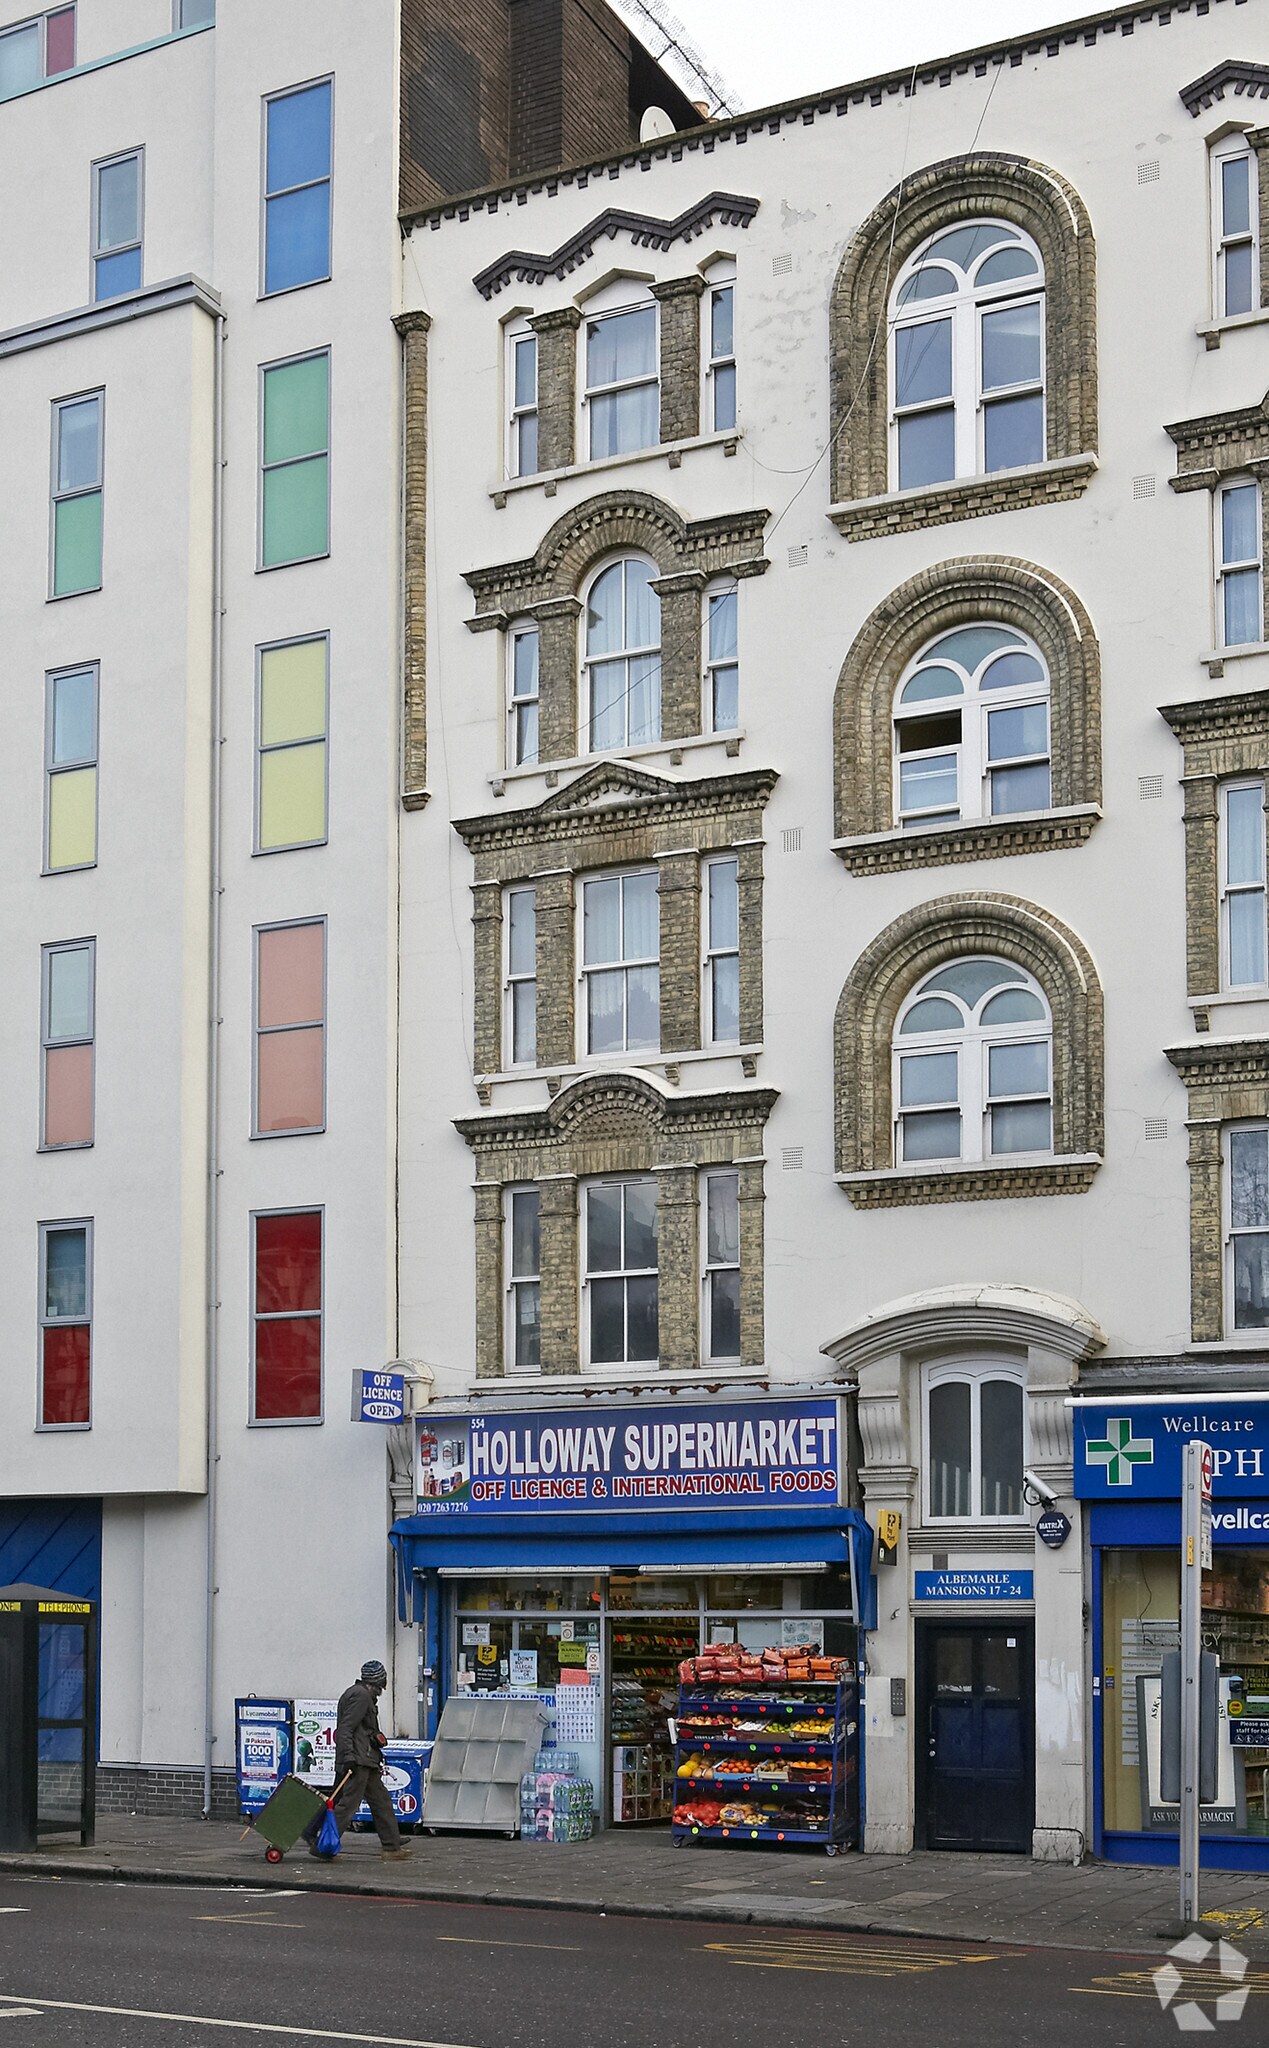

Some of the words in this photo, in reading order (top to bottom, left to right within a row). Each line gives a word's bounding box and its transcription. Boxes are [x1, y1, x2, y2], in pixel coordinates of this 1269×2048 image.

[374, 1374, 392, 1386] OFF
[363, 1386, 403, 1402] LICENCE
[370, 1404, 395, 1416] OPEN
[471, 1418, 485, 1429] 554
[1162, 1416, 1255, 1433] Wellcare
[472, 1426, 616, 1475] HOLLOWAY
[623, 1417, 836, 1471] SUPERMARKET
[472, 1480, 505, 1500] OFF
[510, 1477, 587, 1500] LICENCE
[592, 1477, 608, 1497] &
[612, 1472, 765, 1498] INTERNATIONAL
[770, 1470, 837, 1493] FOODS
[417, 1503, 431, 1513] 020
[432, 1502, 450, 1512] 7263
[451, 1502, 468, 1512] 7276
[937, 1574, 1010, 1584] ALBEMARLE
[926, 1585, 986, 1596] MANSIONS
[989, 1585, 1001, 1595] 17
[1010, 1585, 1021, 1595] 24
[44, 1603, 86, 1612] TELEPHONE
[299, 1709, 337, 1719] Lycamobi
[247, 1746, 271, 1756] 1000
[1166, 1812, 1180, 1822] YOU
